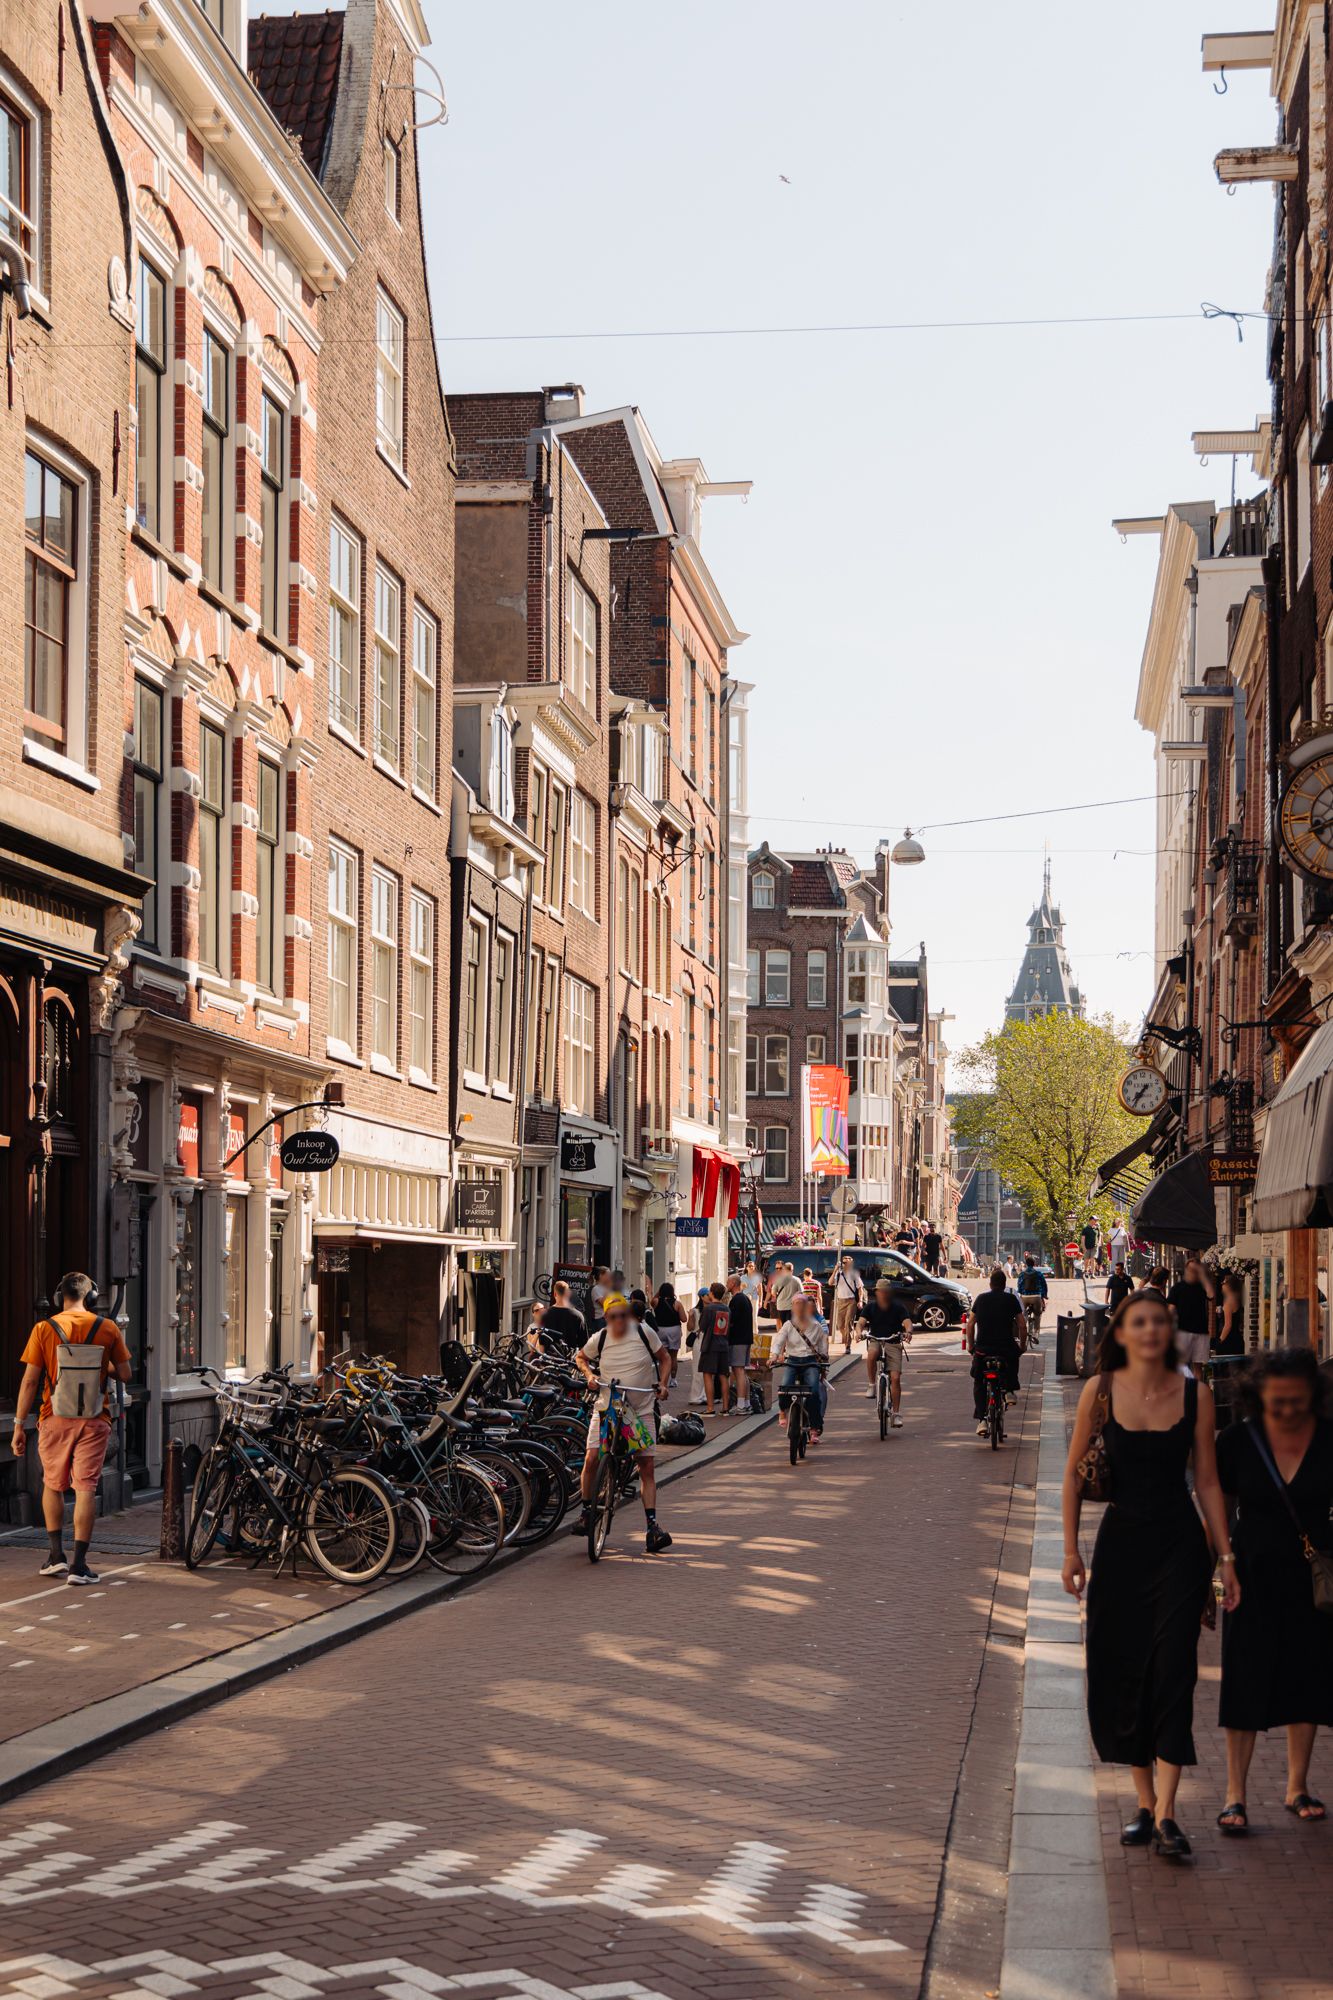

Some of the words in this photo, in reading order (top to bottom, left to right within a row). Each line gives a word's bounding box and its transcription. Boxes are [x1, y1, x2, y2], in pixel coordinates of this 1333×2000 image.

[297, 1139, 326, 1150] Inkoop
[284, 1152, 308, 1165] Oud
[308, 1151, 337, 1165] Goud
